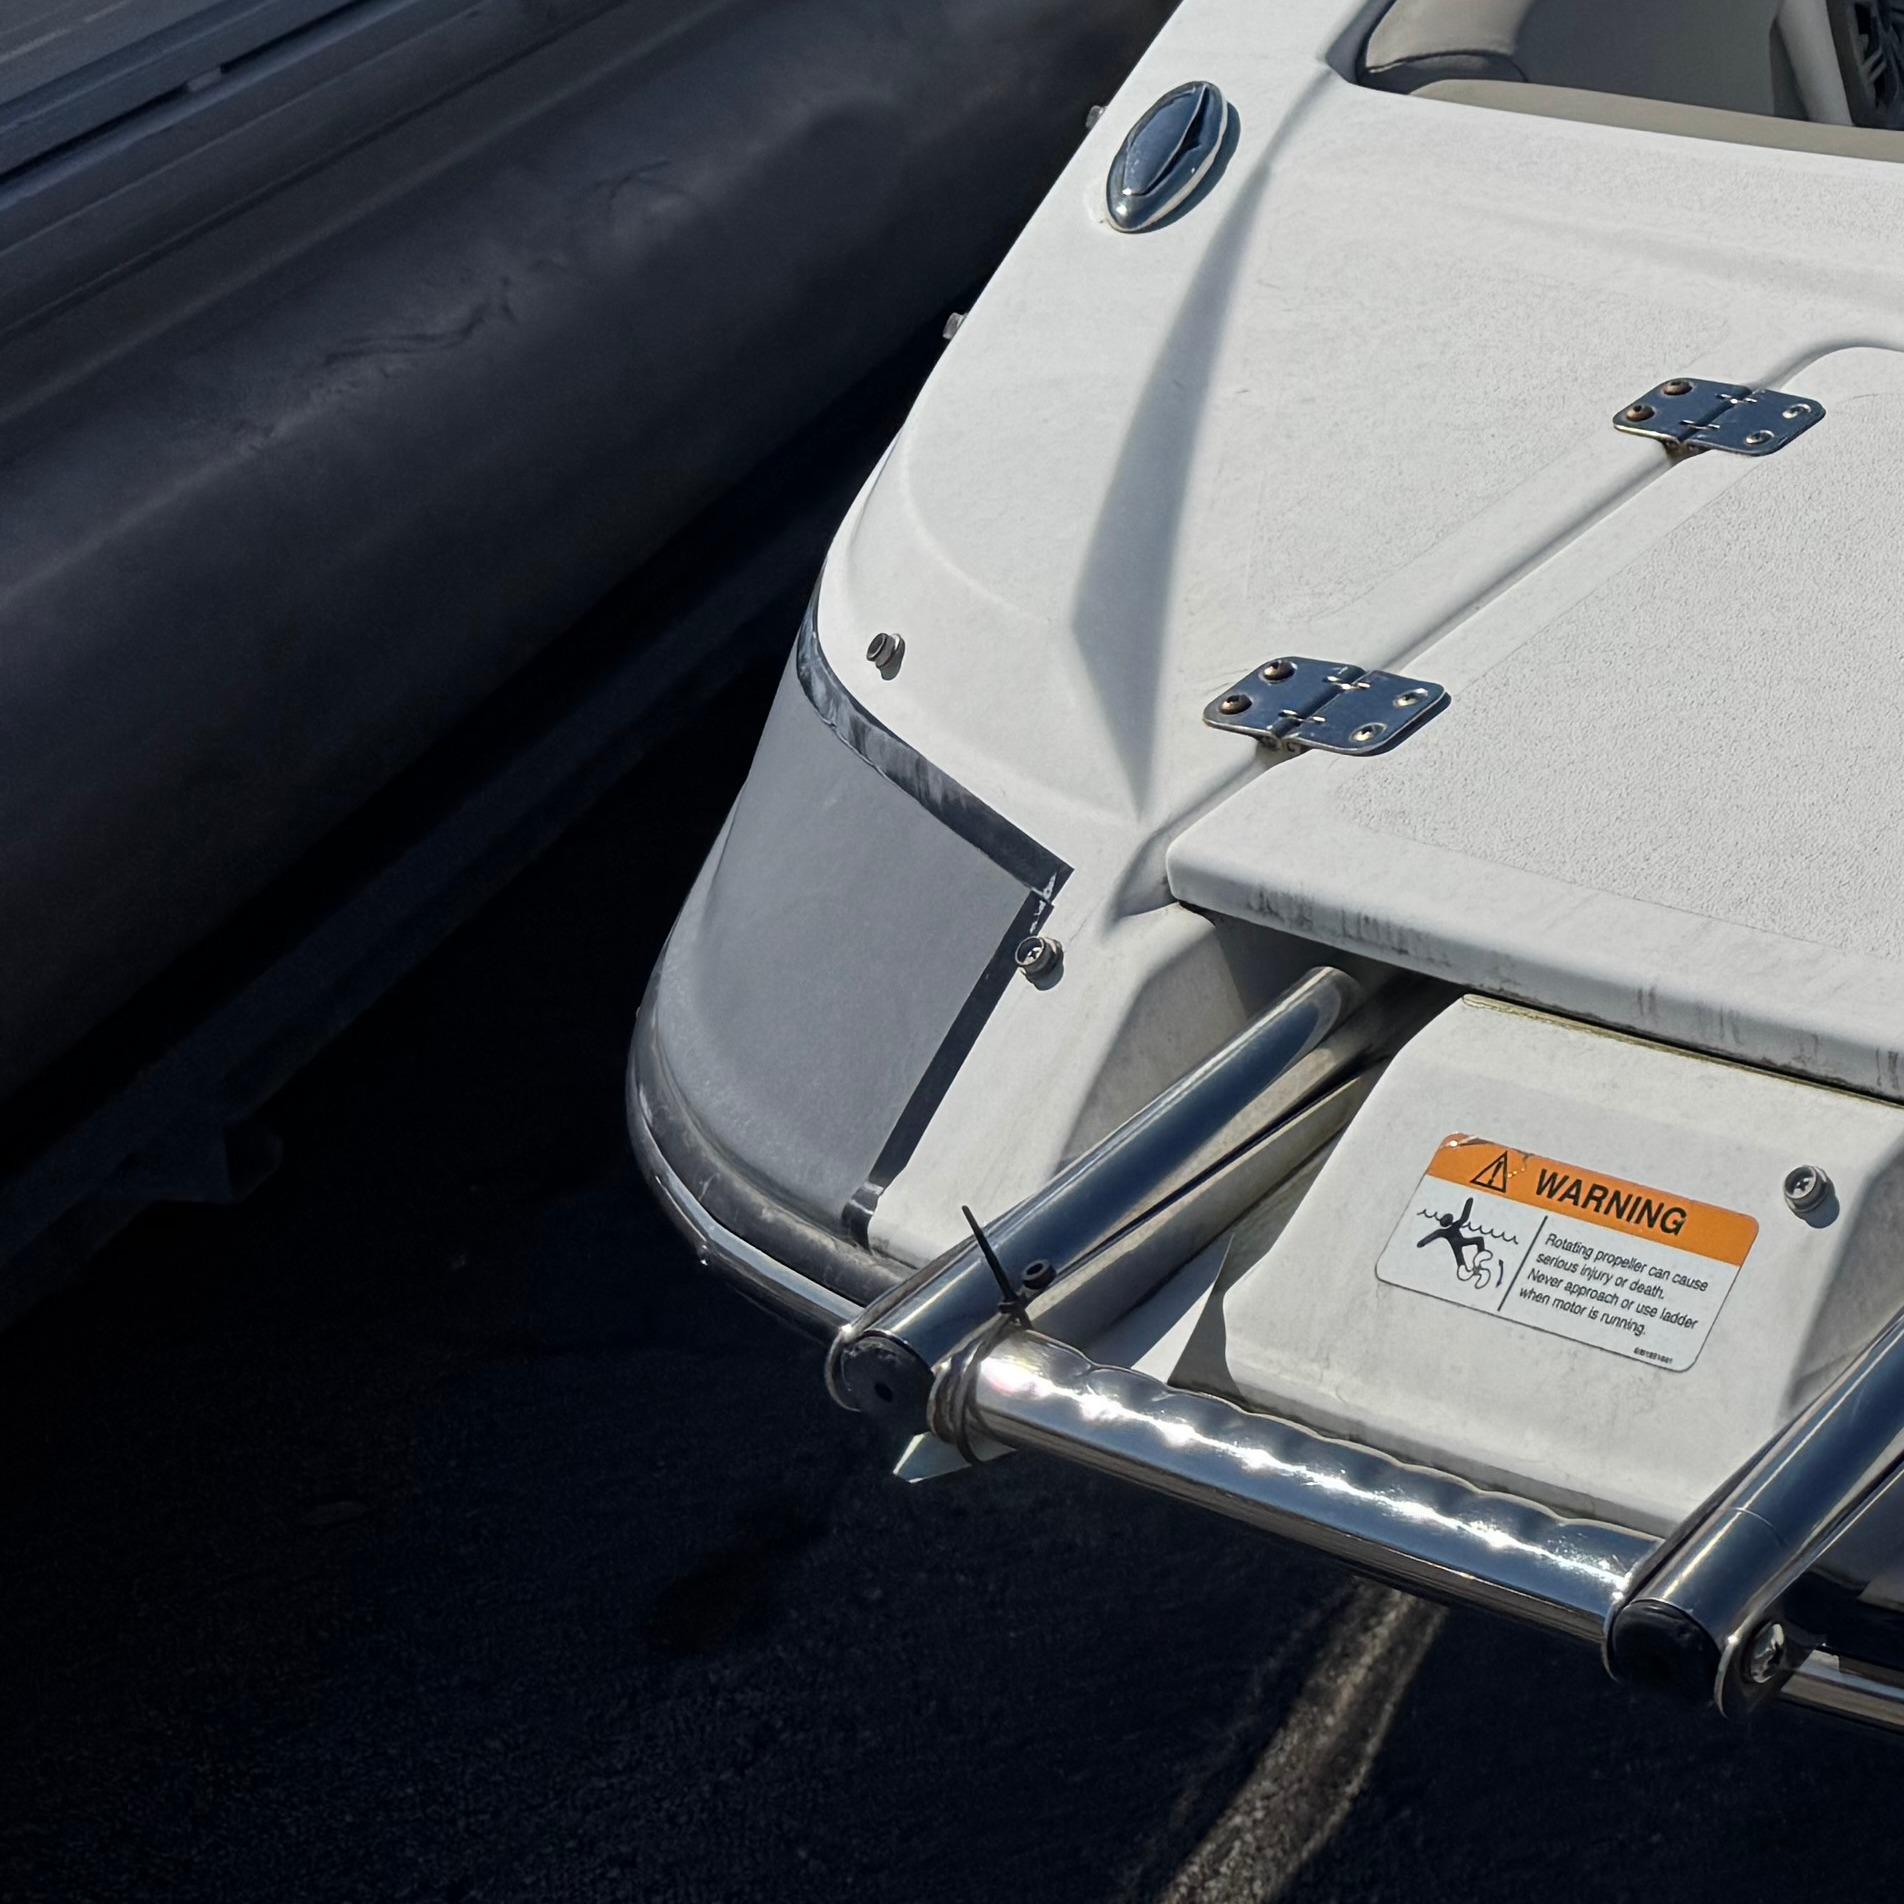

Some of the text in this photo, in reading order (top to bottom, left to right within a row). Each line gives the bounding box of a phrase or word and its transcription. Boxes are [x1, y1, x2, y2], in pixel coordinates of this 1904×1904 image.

[1535, 1168, 1687, 1237] WARNING
[1536, 1252, 1665, 1301] serious injury or death.
[1545, 1233, 1709, 1292] Rotating propeller can cause
[1519, 1286, 1646, 1337] when motor is running.
[1527, 1268, 1698, 1330] Never approach or use ladder
